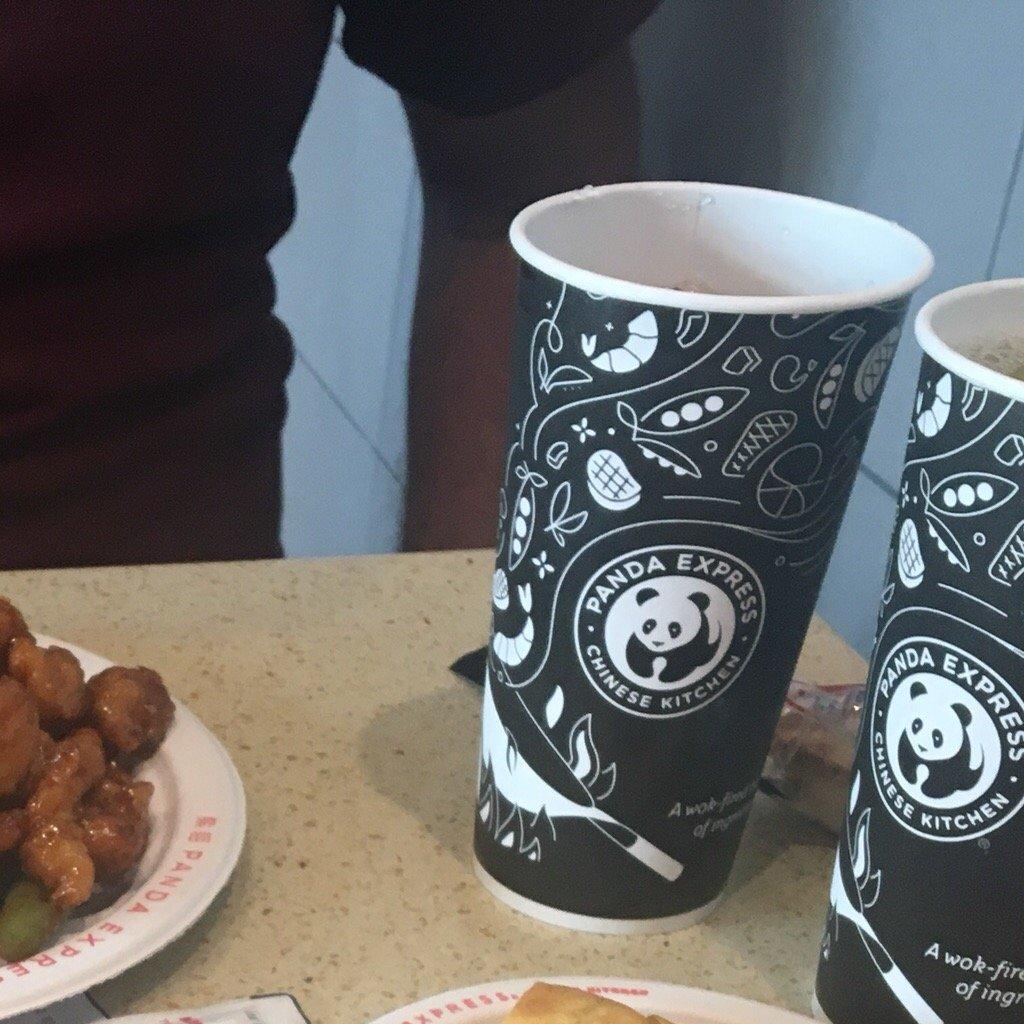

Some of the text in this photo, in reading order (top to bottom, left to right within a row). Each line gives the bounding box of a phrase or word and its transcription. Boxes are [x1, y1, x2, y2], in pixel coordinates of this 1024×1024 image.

[585, 553, 758, 624] PANDA EXPRESS
[586, 644, 741, 710] CHINESE KITCHEN
[880, 647, 1024, 762] PANDA EXPRESS
[873, 731, 1010, 831] CHINESE KITCHEN
[126, 850, 204, 915] PANDA
[924, 942, 940, 960] A
[955, 980, 982, 1002] of
